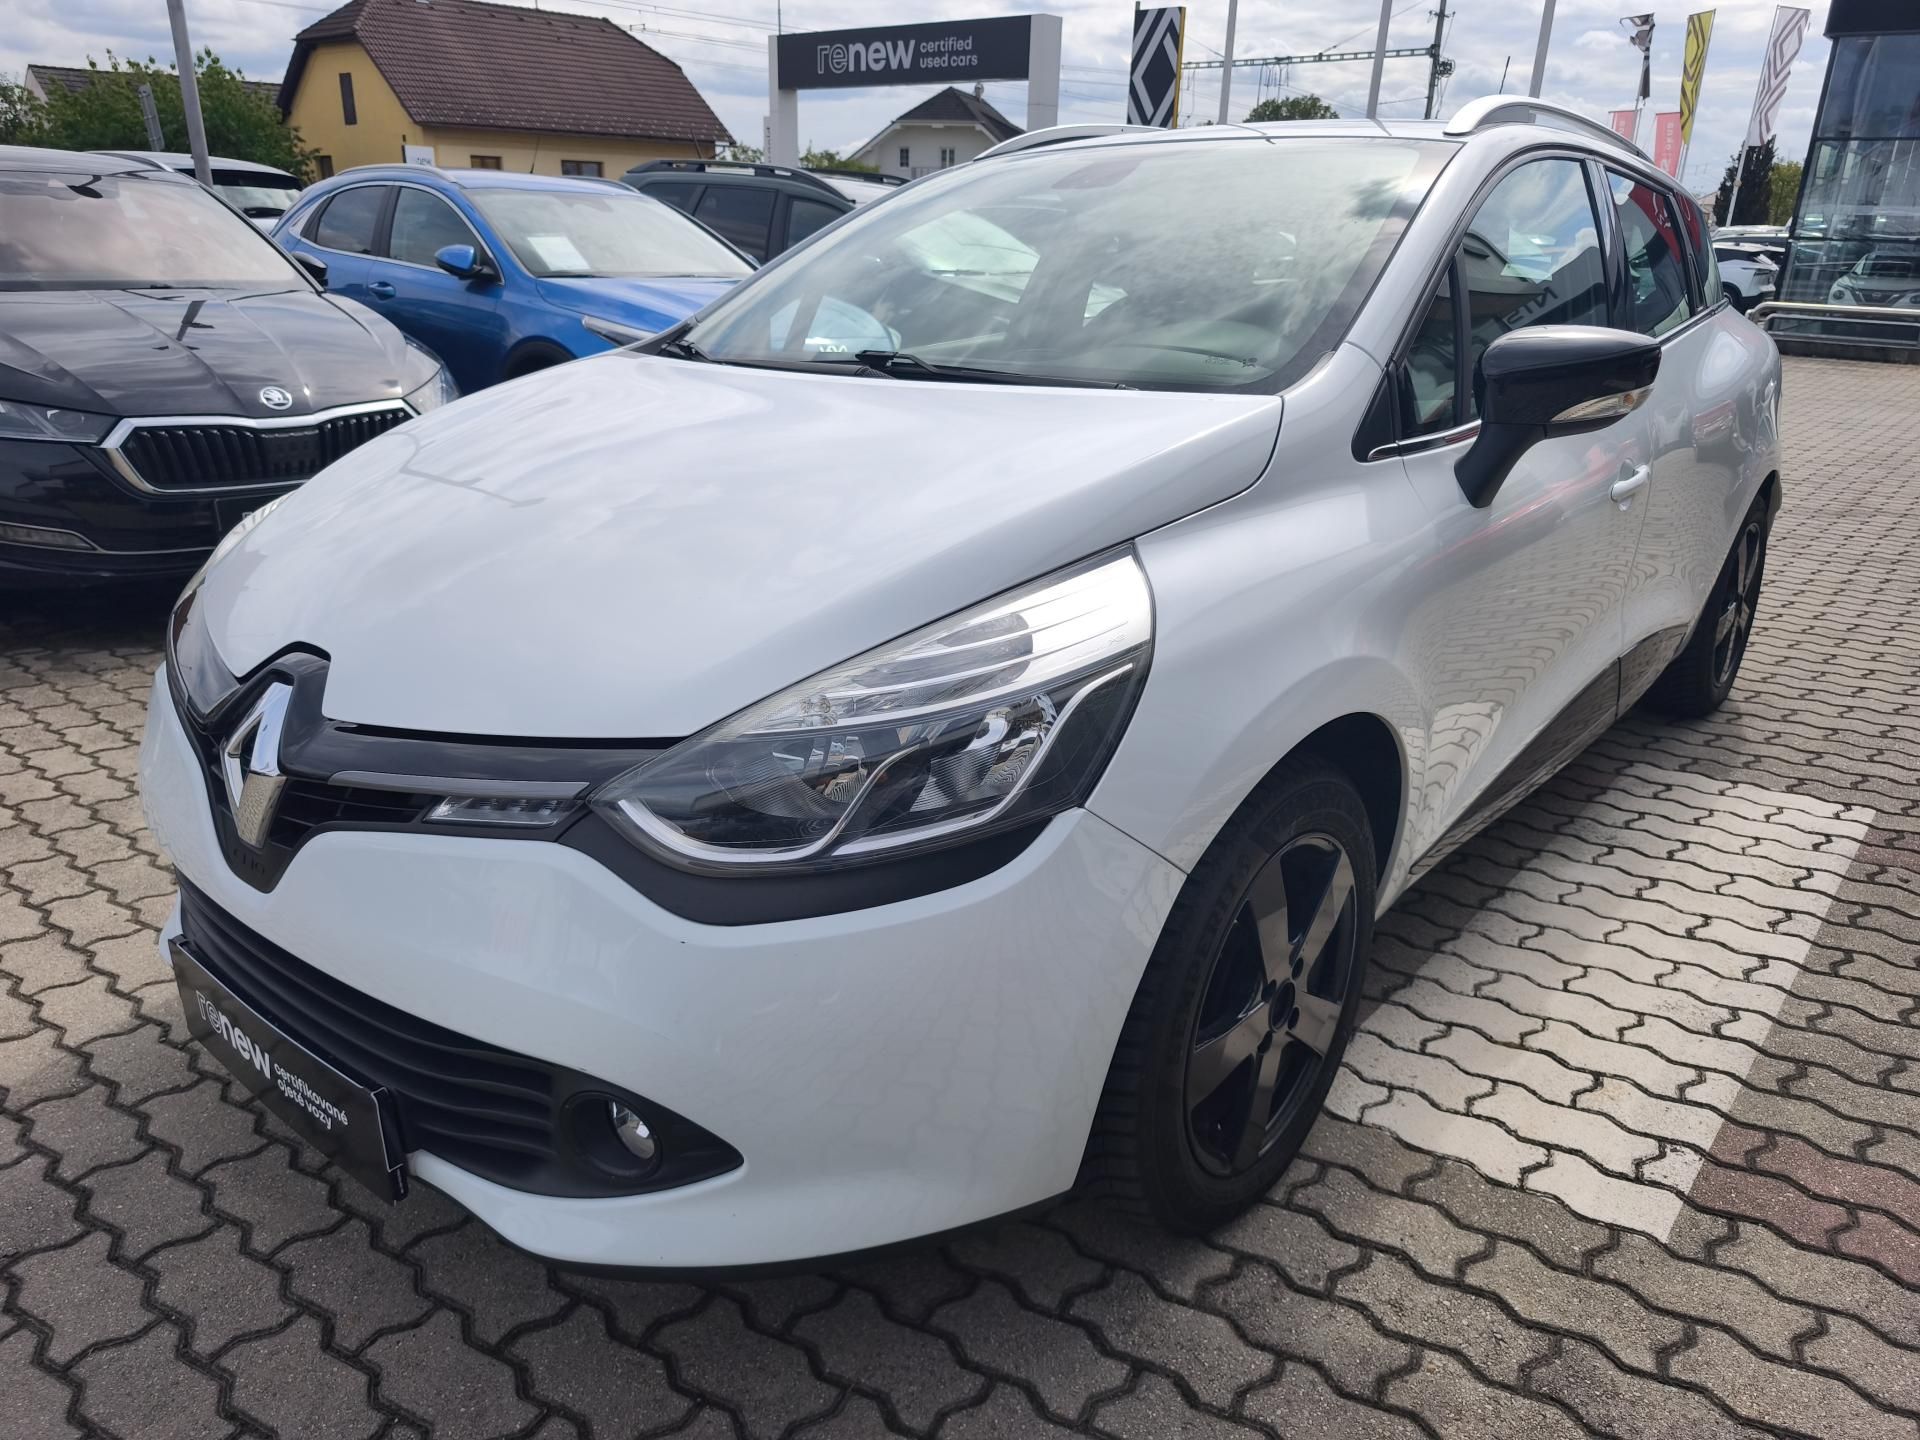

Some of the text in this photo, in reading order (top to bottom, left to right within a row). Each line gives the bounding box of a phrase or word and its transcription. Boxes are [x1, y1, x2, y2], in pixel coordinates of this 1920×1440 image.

[817, 39, 916, 74] renew
[919, 35, 973, 53] certified
[919, 54, 978, 68] used cars
[195, 989, 271, 1080] renew
[273, 1063, 349, 1126] certifikované
[277, 1078, 332, 1130] ojeté vozy
